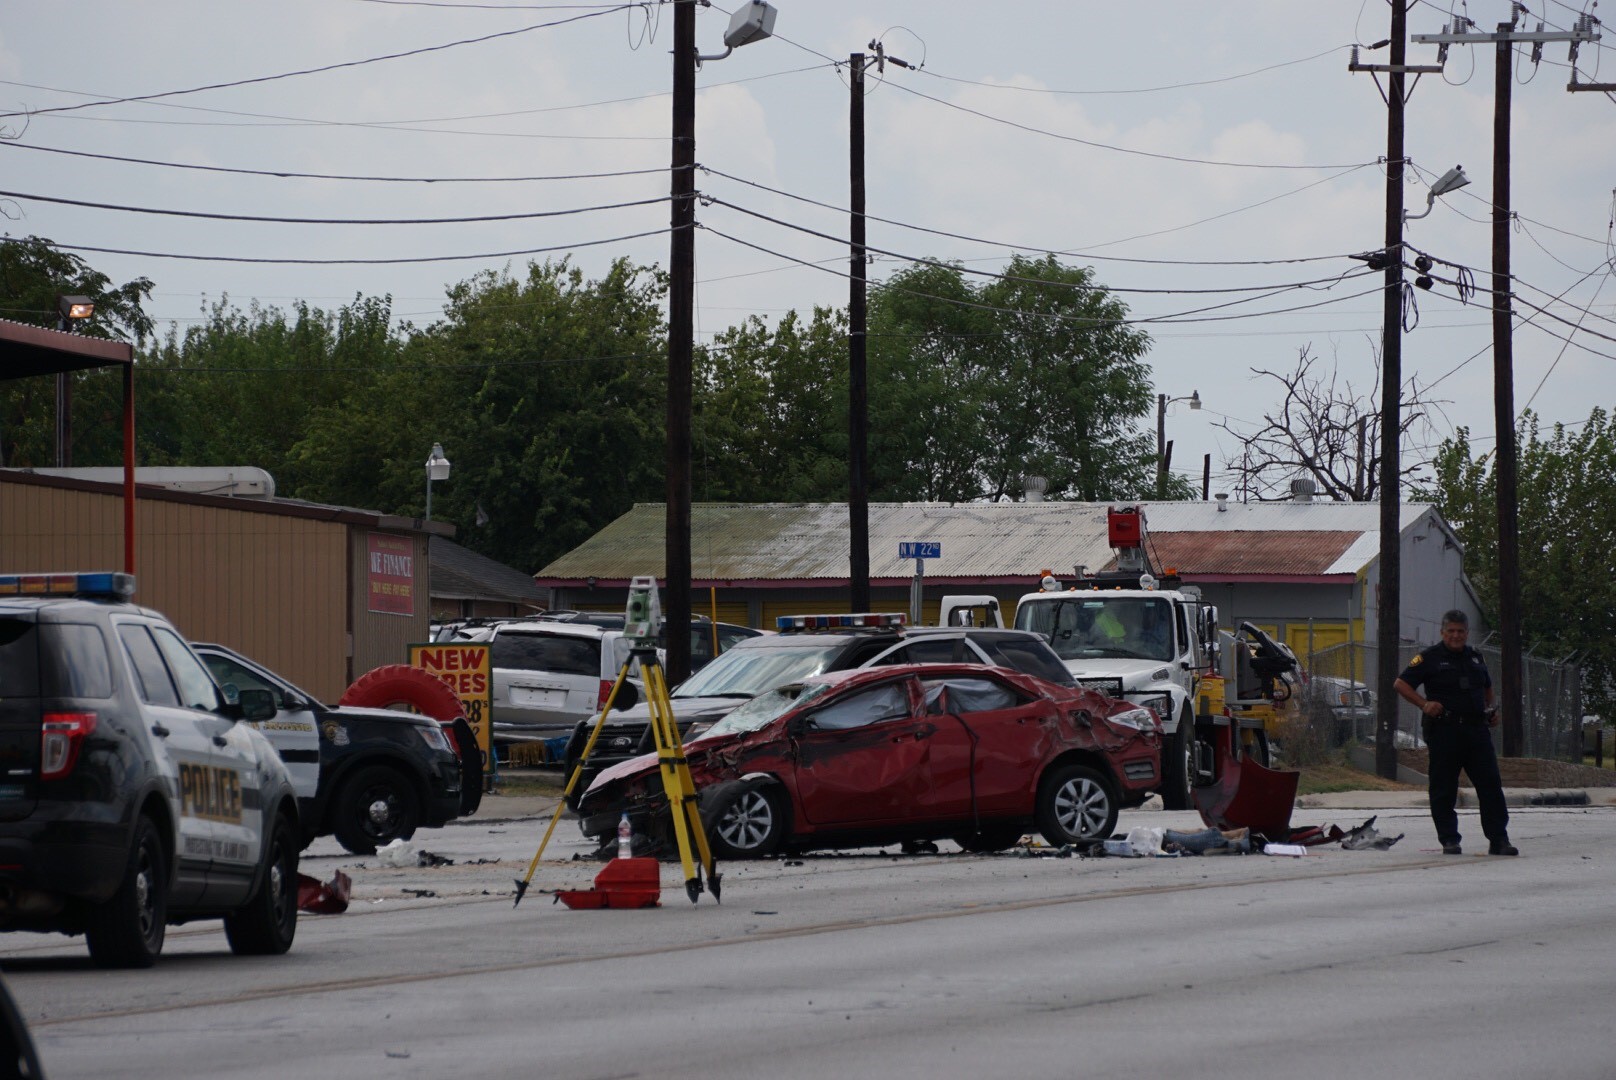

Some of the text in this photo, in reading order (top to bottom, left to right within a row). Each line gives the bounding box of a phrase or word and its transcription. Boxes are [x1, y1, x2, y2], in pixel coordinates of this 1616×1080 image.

[370, 551, 413, 577] WE FINANCE
[420, 649, 485, 671] NEW
[441, 673, 486, 693] RES
[178, 764, 241, 824] POLICE
